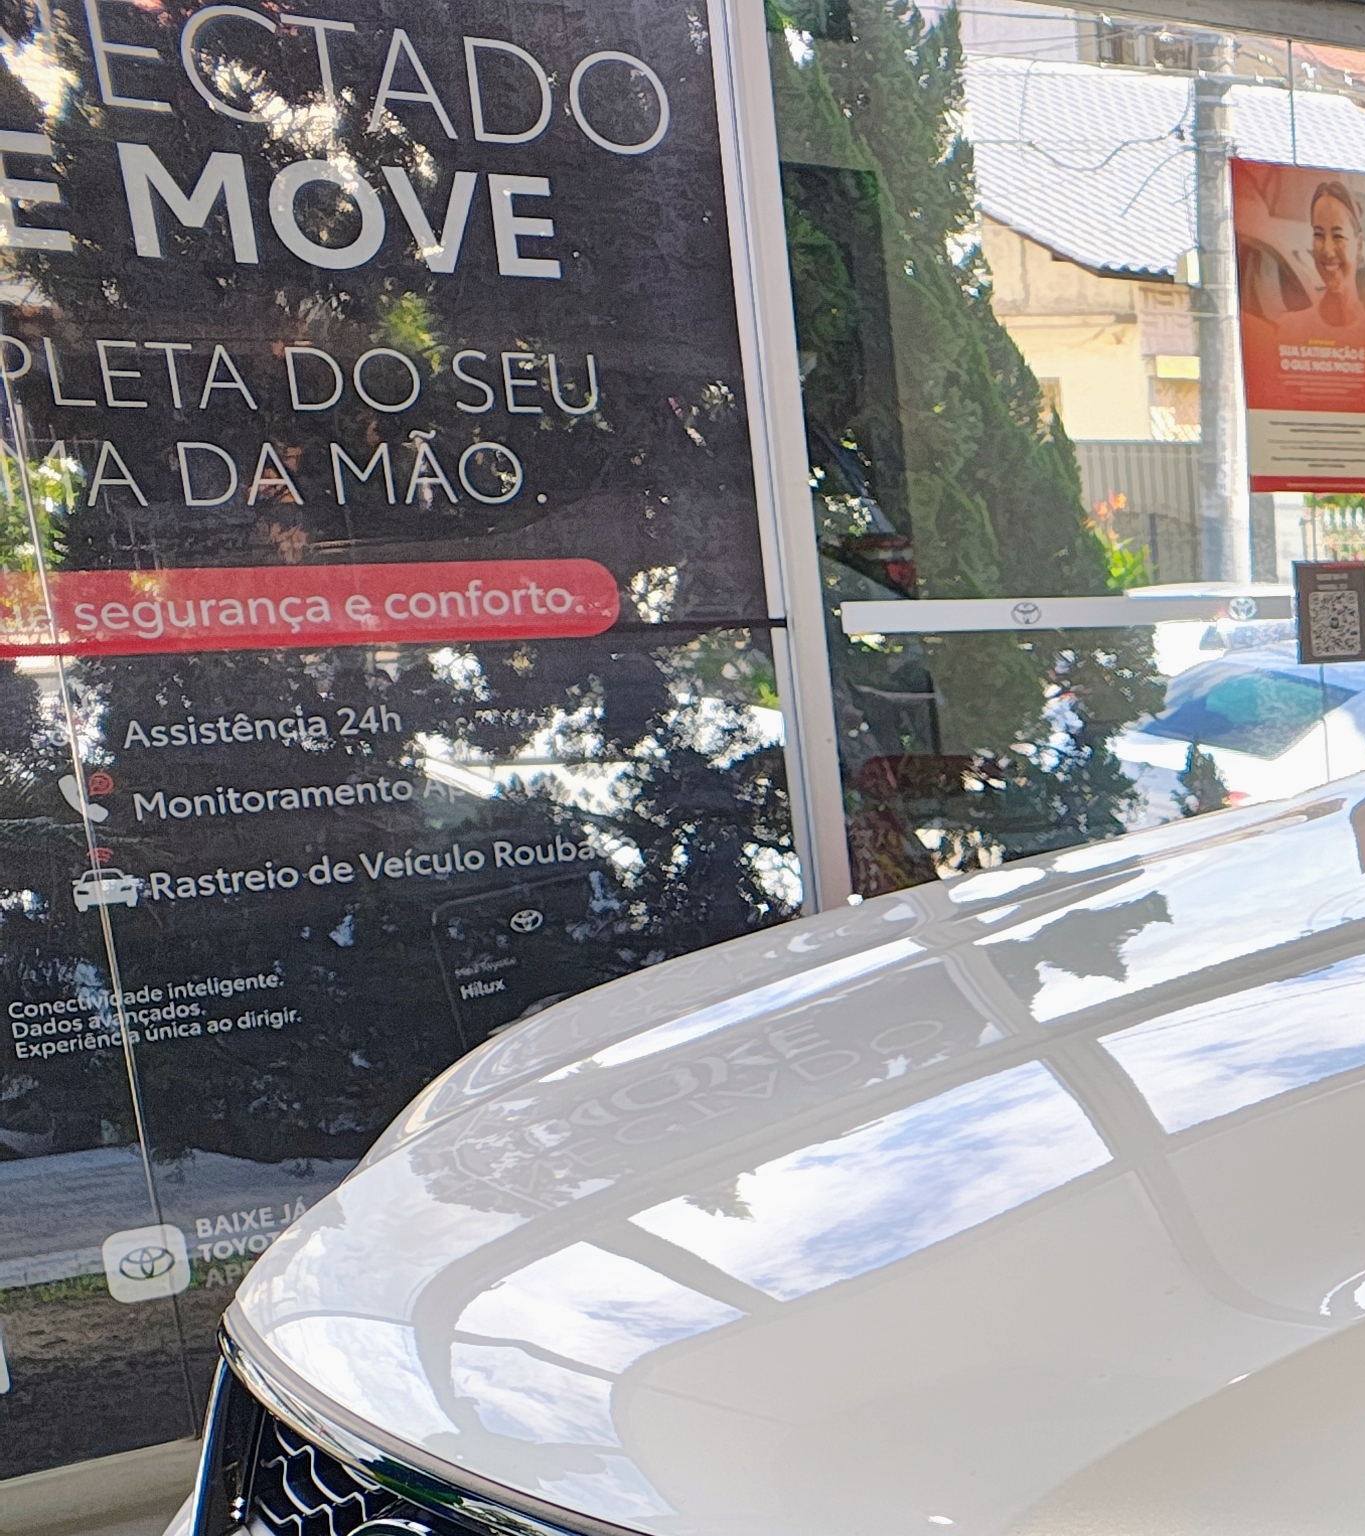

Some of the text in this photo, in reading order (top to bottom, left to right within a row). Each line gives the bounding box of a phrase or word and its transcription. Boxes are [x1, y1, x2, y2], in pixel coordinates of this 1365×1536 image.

[117, 142, 562, 280] MOVE
[284, 346, 421, 413] DO
[452, 349, 599, 415] SEU
[177, 441, 304, 507] DA
[330, 429, 548, 505] MÃO.
[74, 595, 332, 639] segurança
[345, 594, 372, 620] e
[384, 579, 586, 619] conforto.
[123, 704, 402, 751] Assistência 24h
[132, 779, 413, 823] Monitoramento
[150, 861, 300, 901] Rastreio
[309, 855, 354, 887] de
[359, 843, 485, 881] Veículo
[168, 972, 285, 1001] inteligente.
[460, 979, 506, 1000] Hilux
[11, 1013, 83, 1040] Dados
[145, 1020, 202, 1042] única
[206, 1016, 232, 1034] ao
[236, 1005, 303, 1032] dirigir.
[195, 1195, 307, 1239] BAIXE JÁ
